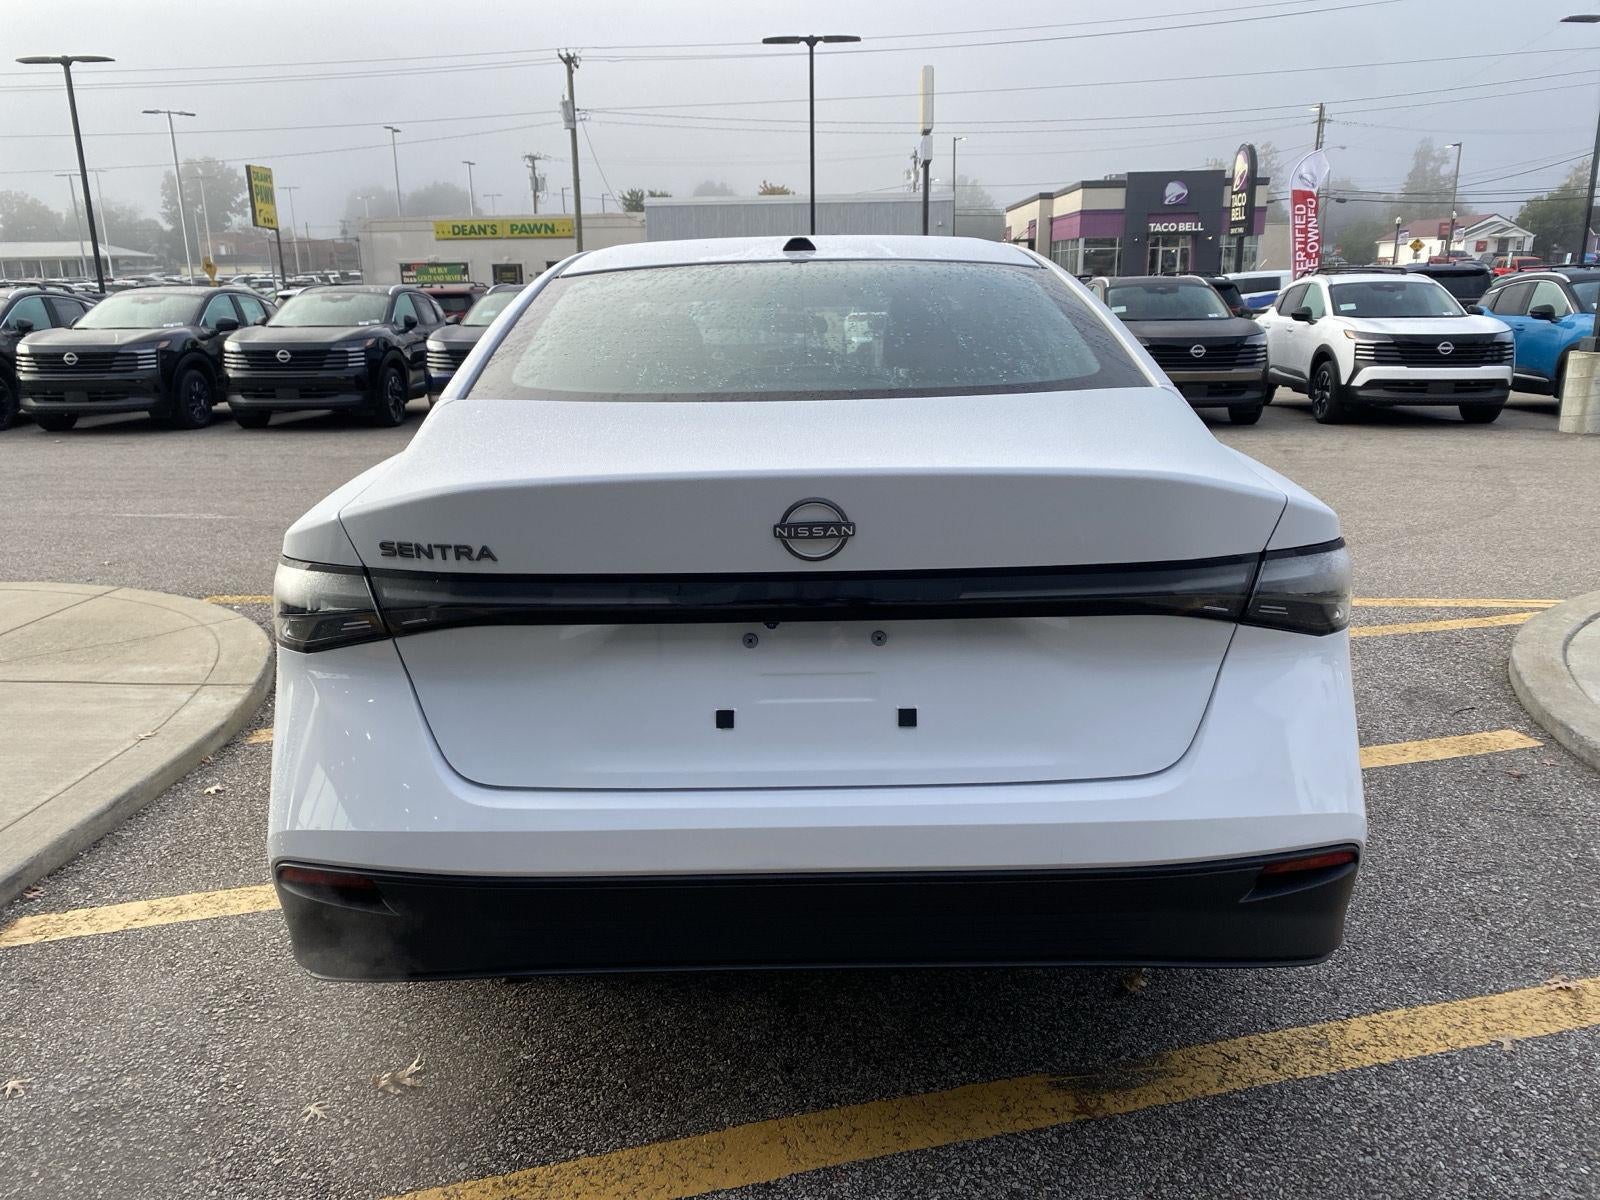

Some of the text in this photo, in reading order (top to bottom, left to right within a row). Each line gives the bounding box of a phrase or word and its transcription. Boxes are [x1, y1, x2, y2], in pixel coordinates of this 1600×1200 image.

[254, 184, 274, 205] PAWN
[1231, 192, 1247, 208] TACO
[1231, 207, 1246, 221] BELL
[451, 223, 555, 235] DEAN'S PAWN
[1149, 222, 1204, 232] TACO BELL
[775, 526, 853, 537] NISSAN
[379, 541, 498, 561] SENTRA
